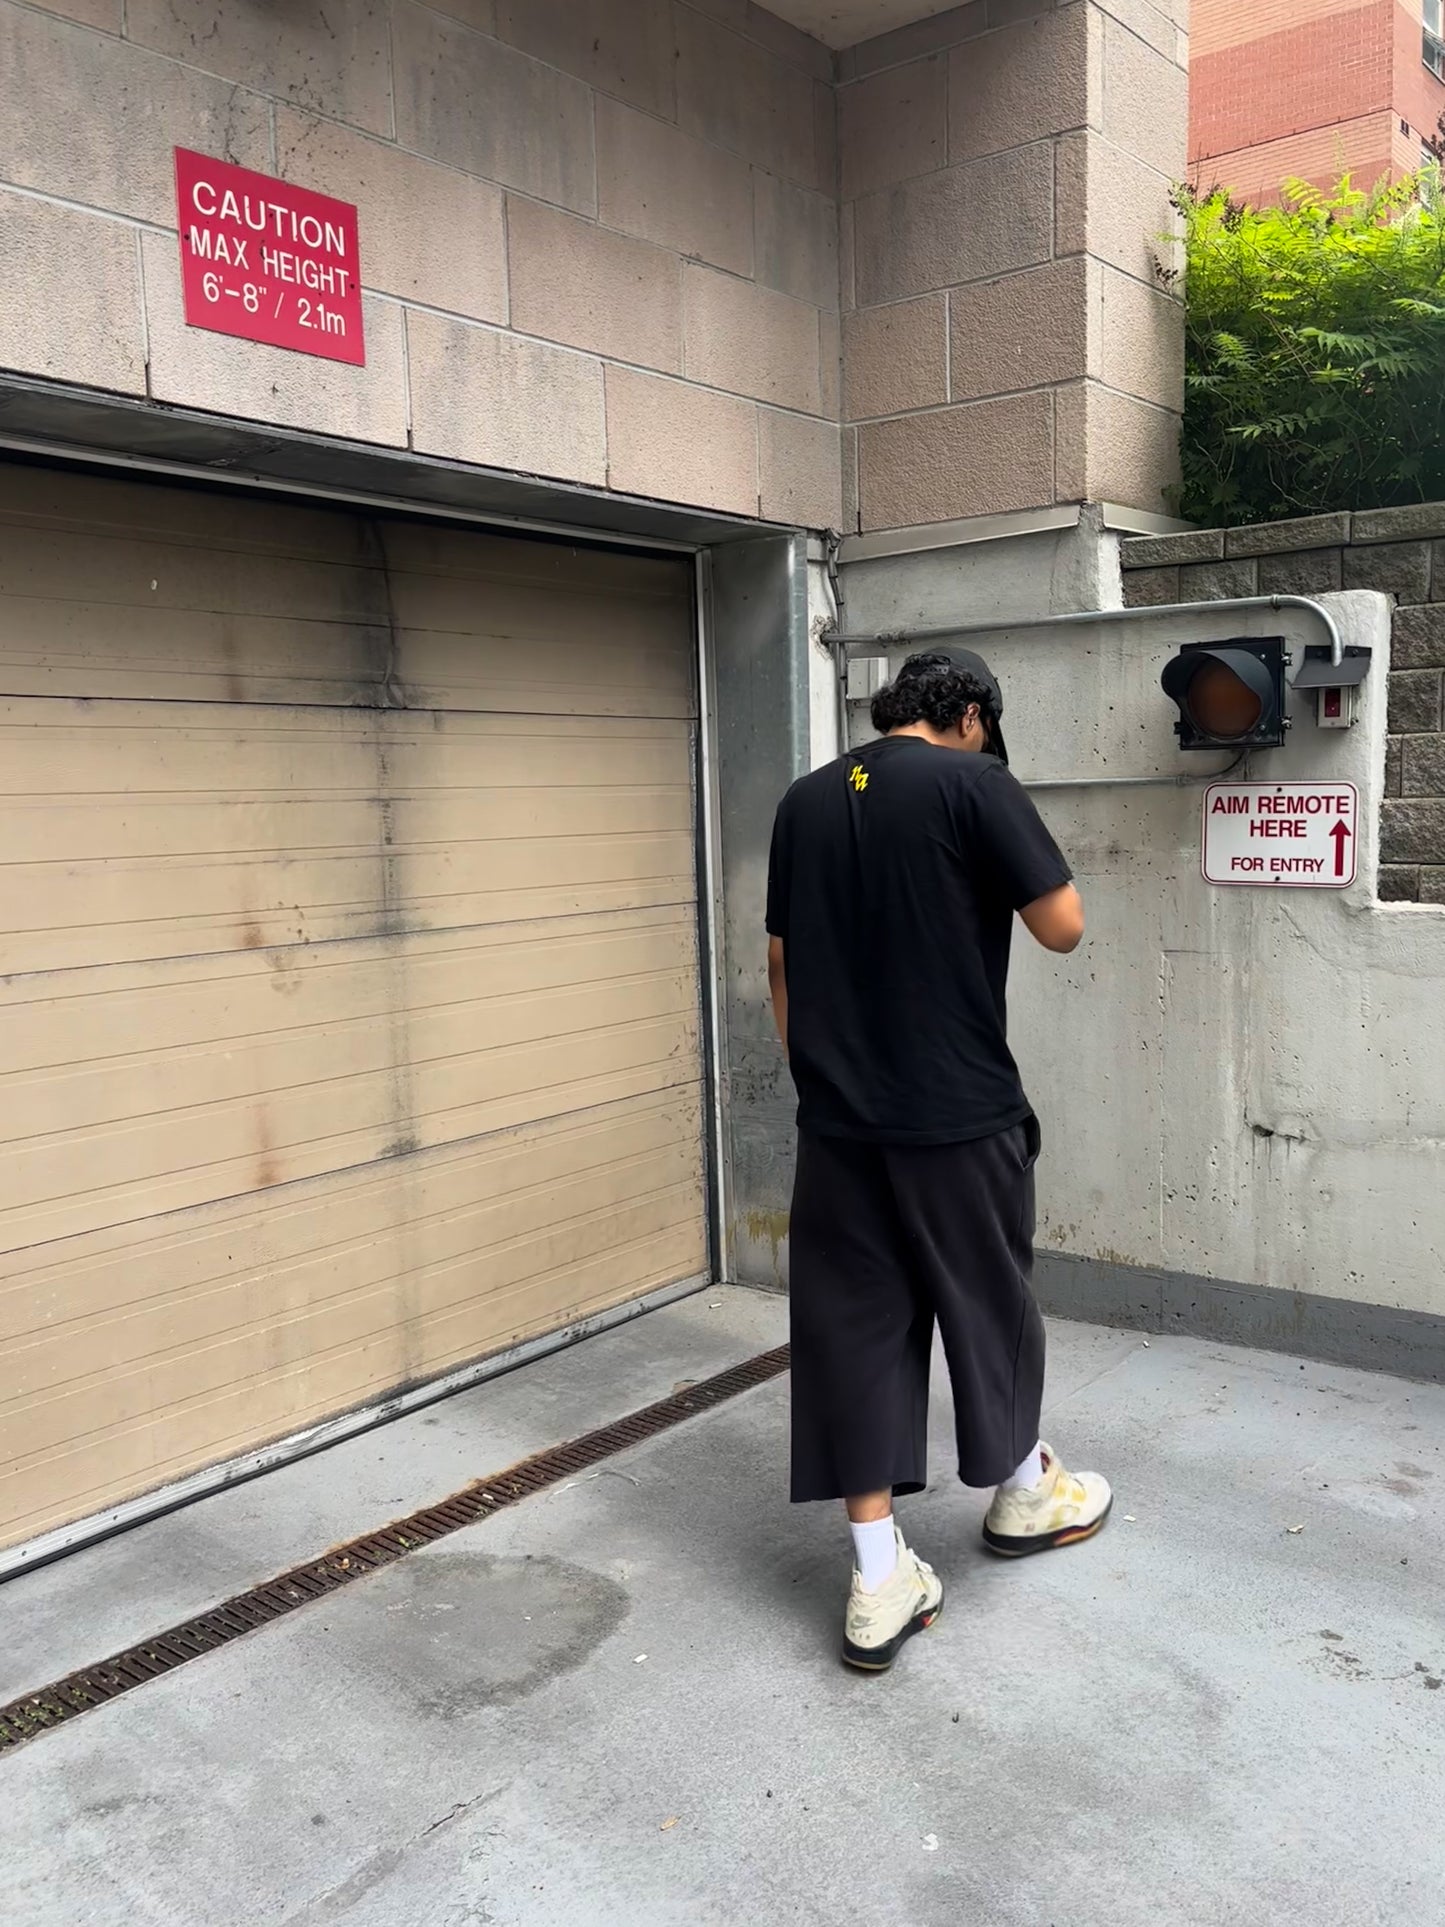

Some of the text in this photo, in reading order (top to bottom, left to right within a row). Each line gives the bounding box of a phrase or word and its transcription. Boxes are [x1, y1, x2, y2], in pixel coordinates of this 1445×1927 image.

[193, 181, 345, 257] CAUTION
[190, 225, 349, 297] MAX HEIGHT
[297, 298, 346, 336] 2.1m
[1211, 795, 1350, 814] AIM REMOTE
[1249, 819, 1307, 838] HERE
[1230, 857, 1325, 873] FOR ENTRY
